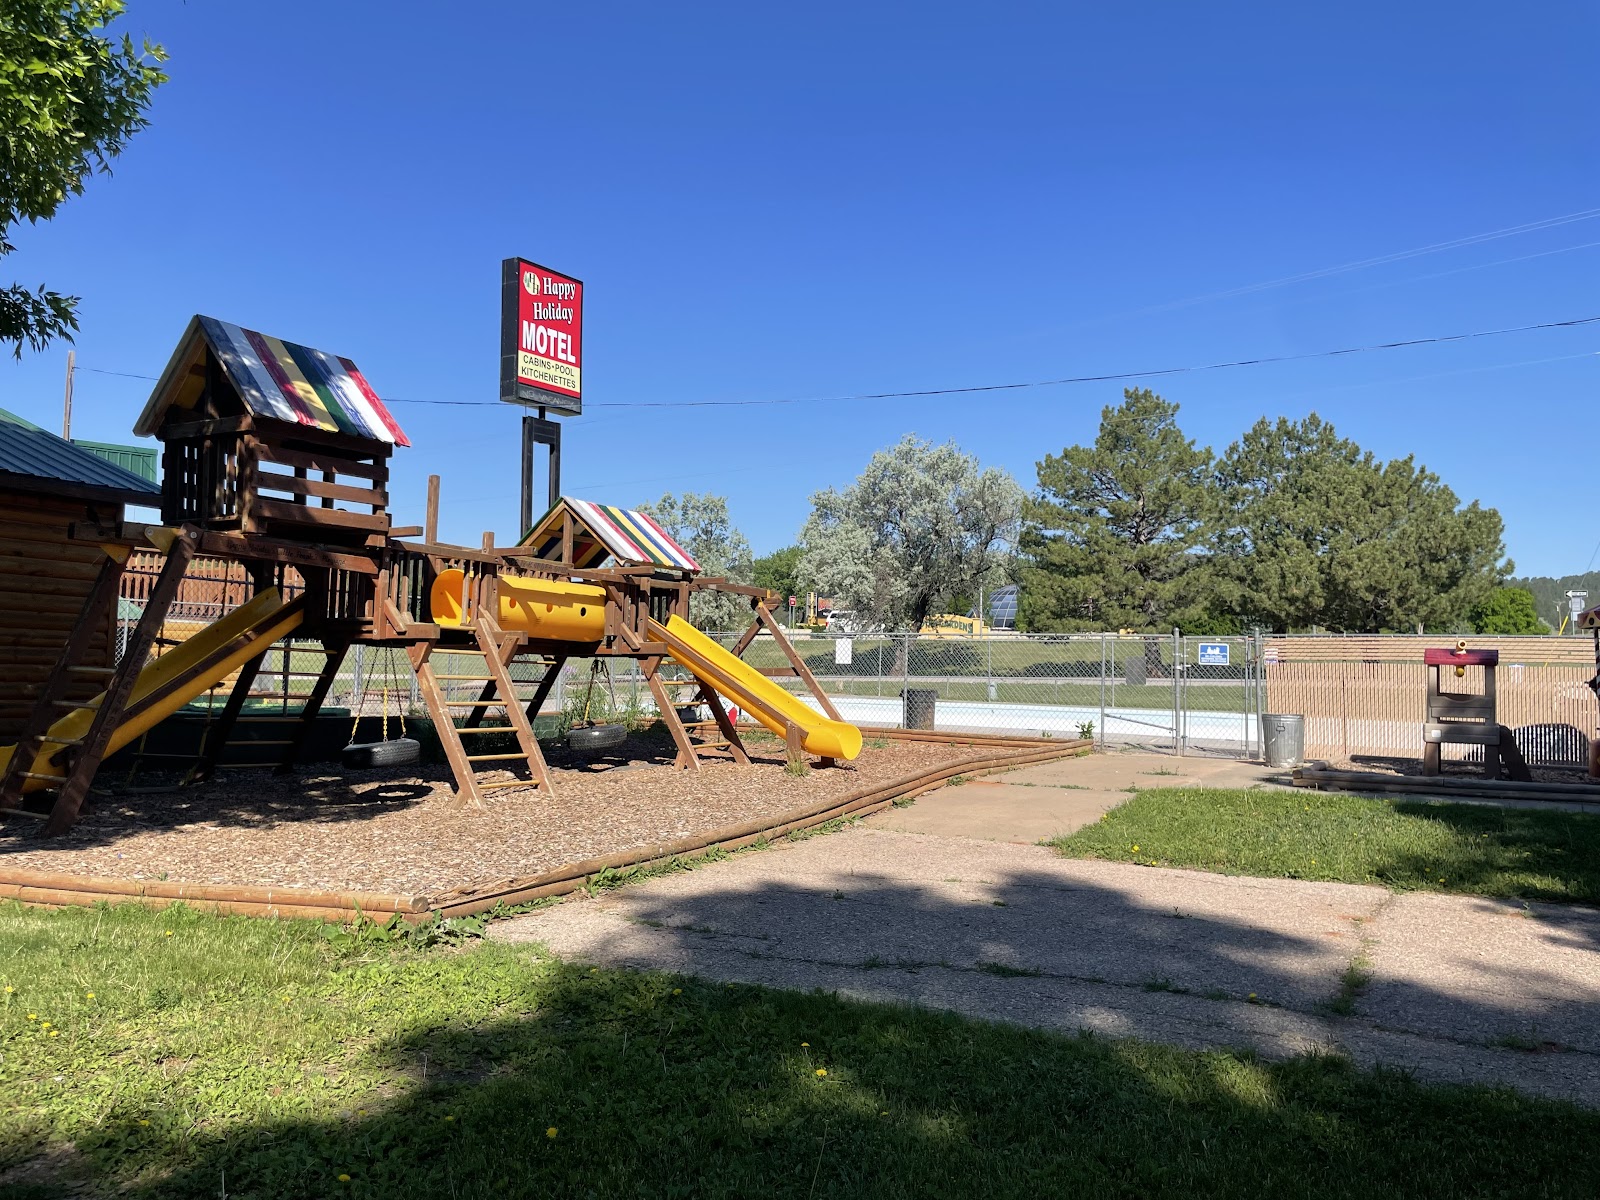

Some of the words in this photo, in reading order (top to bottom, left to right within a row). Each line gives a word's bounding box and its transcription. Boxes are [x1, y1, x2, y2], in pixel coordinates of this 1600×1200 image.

[542, 277, 576, 300] Happy
[533, 302, 574, 325] Holiday
[522, 319, 577, 364] MOTEL
[521, 366, 576, 389] KITCHENETTES
